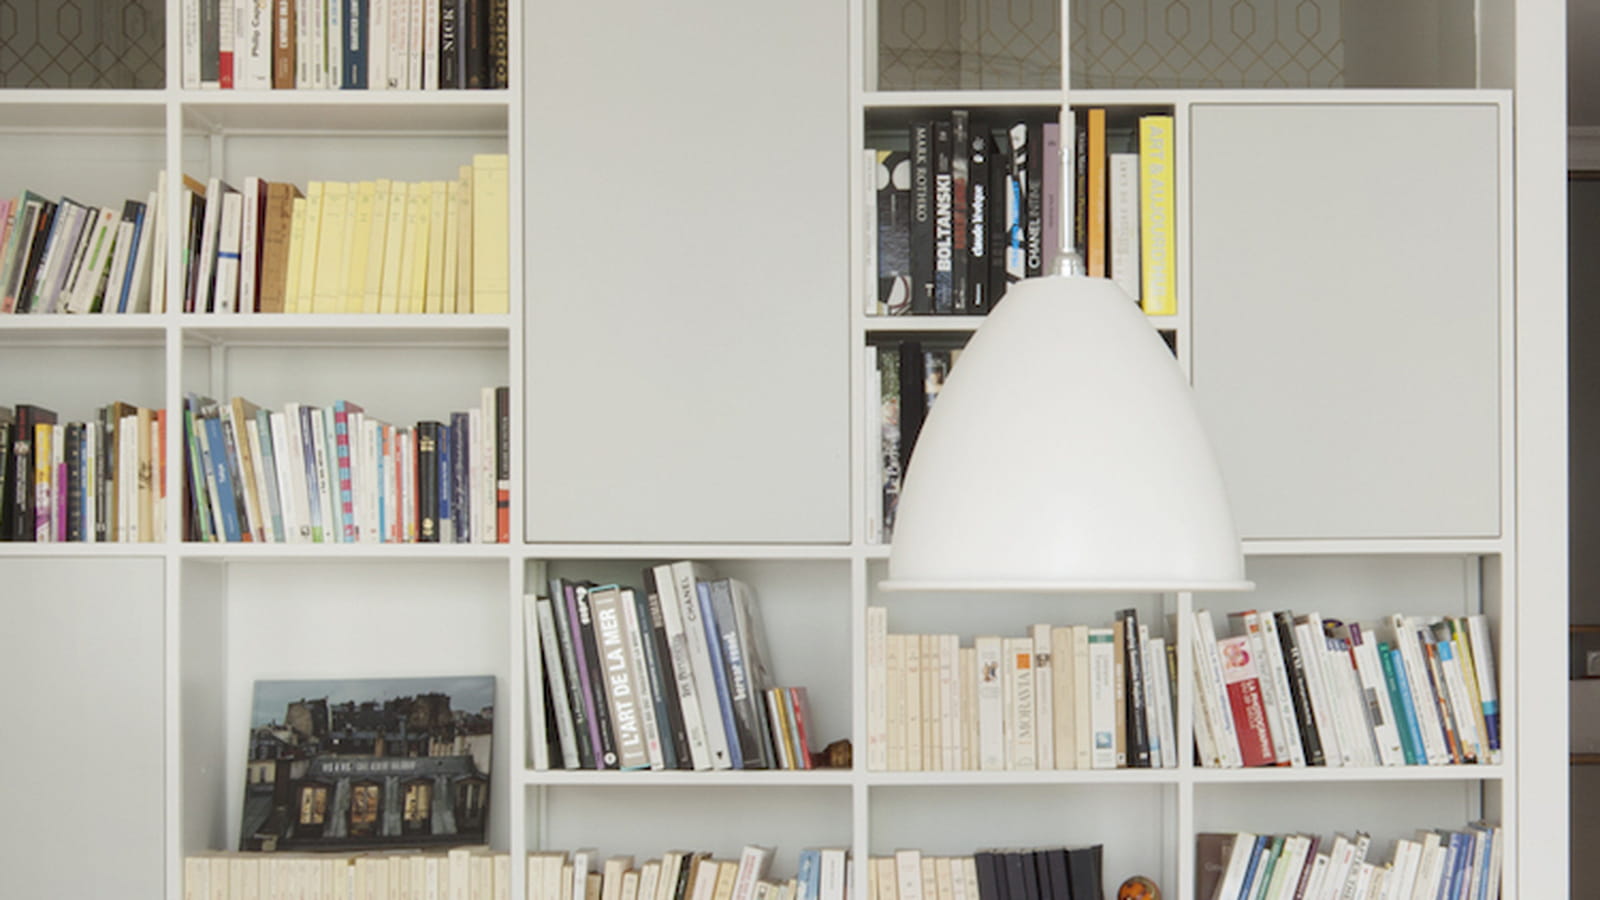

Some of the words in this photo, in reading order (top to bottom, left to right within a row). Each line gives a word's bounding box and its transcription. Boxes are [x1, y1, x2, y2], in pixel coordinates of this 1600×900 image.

[443, 8, 455, 52] NICK
[916, 127, 927, 163] MARK
[1148, 125, 1165, 161] ART
[1148, 163, 1165, 175] &
[915, 167, 927, 222] ROTHKO
[936, 174, 952, 272] BOLTANSKI
[971, 224, 984, 257] claude
[1027, 218, 1041, 269] CHANEL
[1149, 178, 1167, 296] AUJOURD'HUI
[680, 576, 697, 622] CHANEL
[599, 608, 621, 646] MER
[607, 648, 625, 670] LA
[611, 673, 630, 697] DE
[1018, 672, 1031, 738] MORAVIA
[1247, 680, 1256, 690] LA
[616, 699, 639, 747] L'ART
